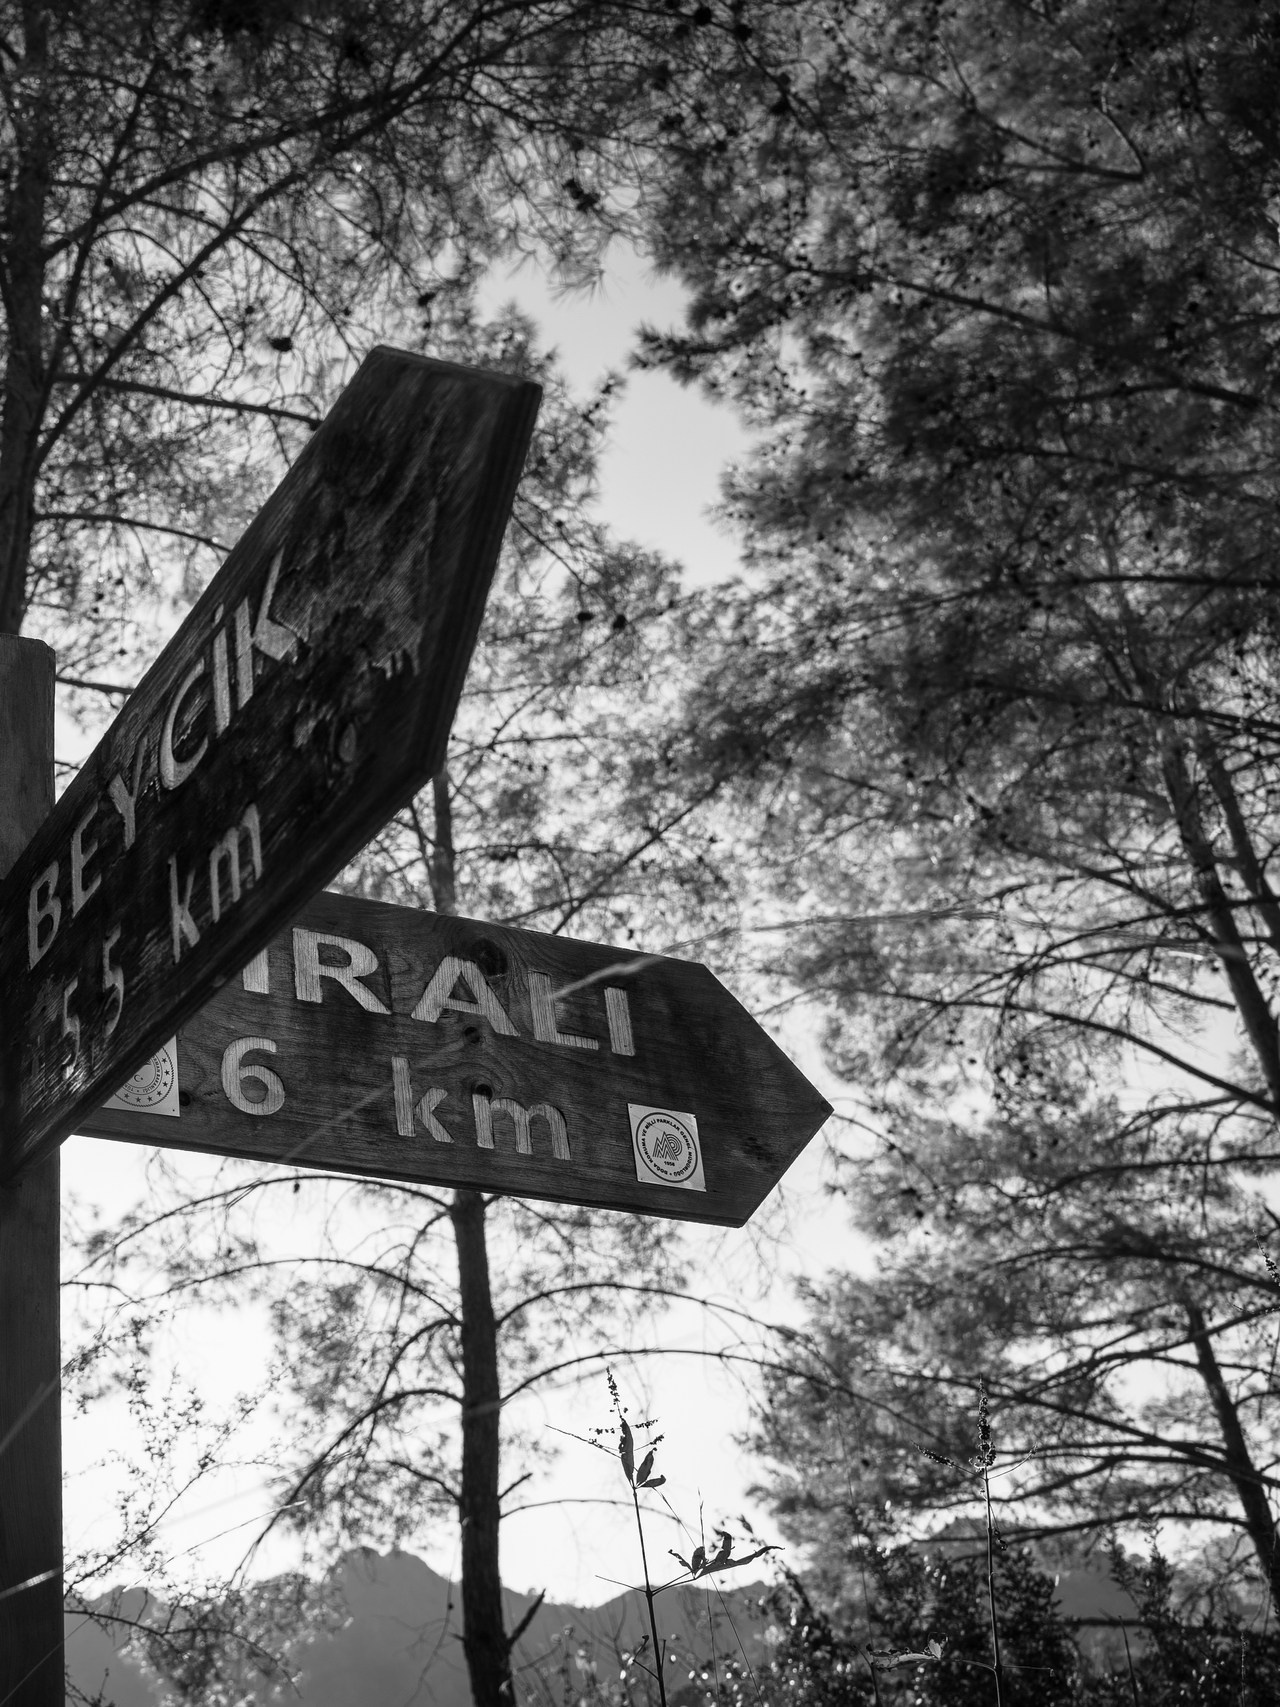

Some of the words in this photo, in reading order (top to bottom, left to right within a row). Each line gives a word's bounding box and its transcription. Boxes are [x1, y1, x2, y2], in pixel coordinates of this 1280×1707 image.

[166, 802, 263, 965] km
[220, 1036, 286, 1117] 6
[390, 1055, 572, 1161] km
